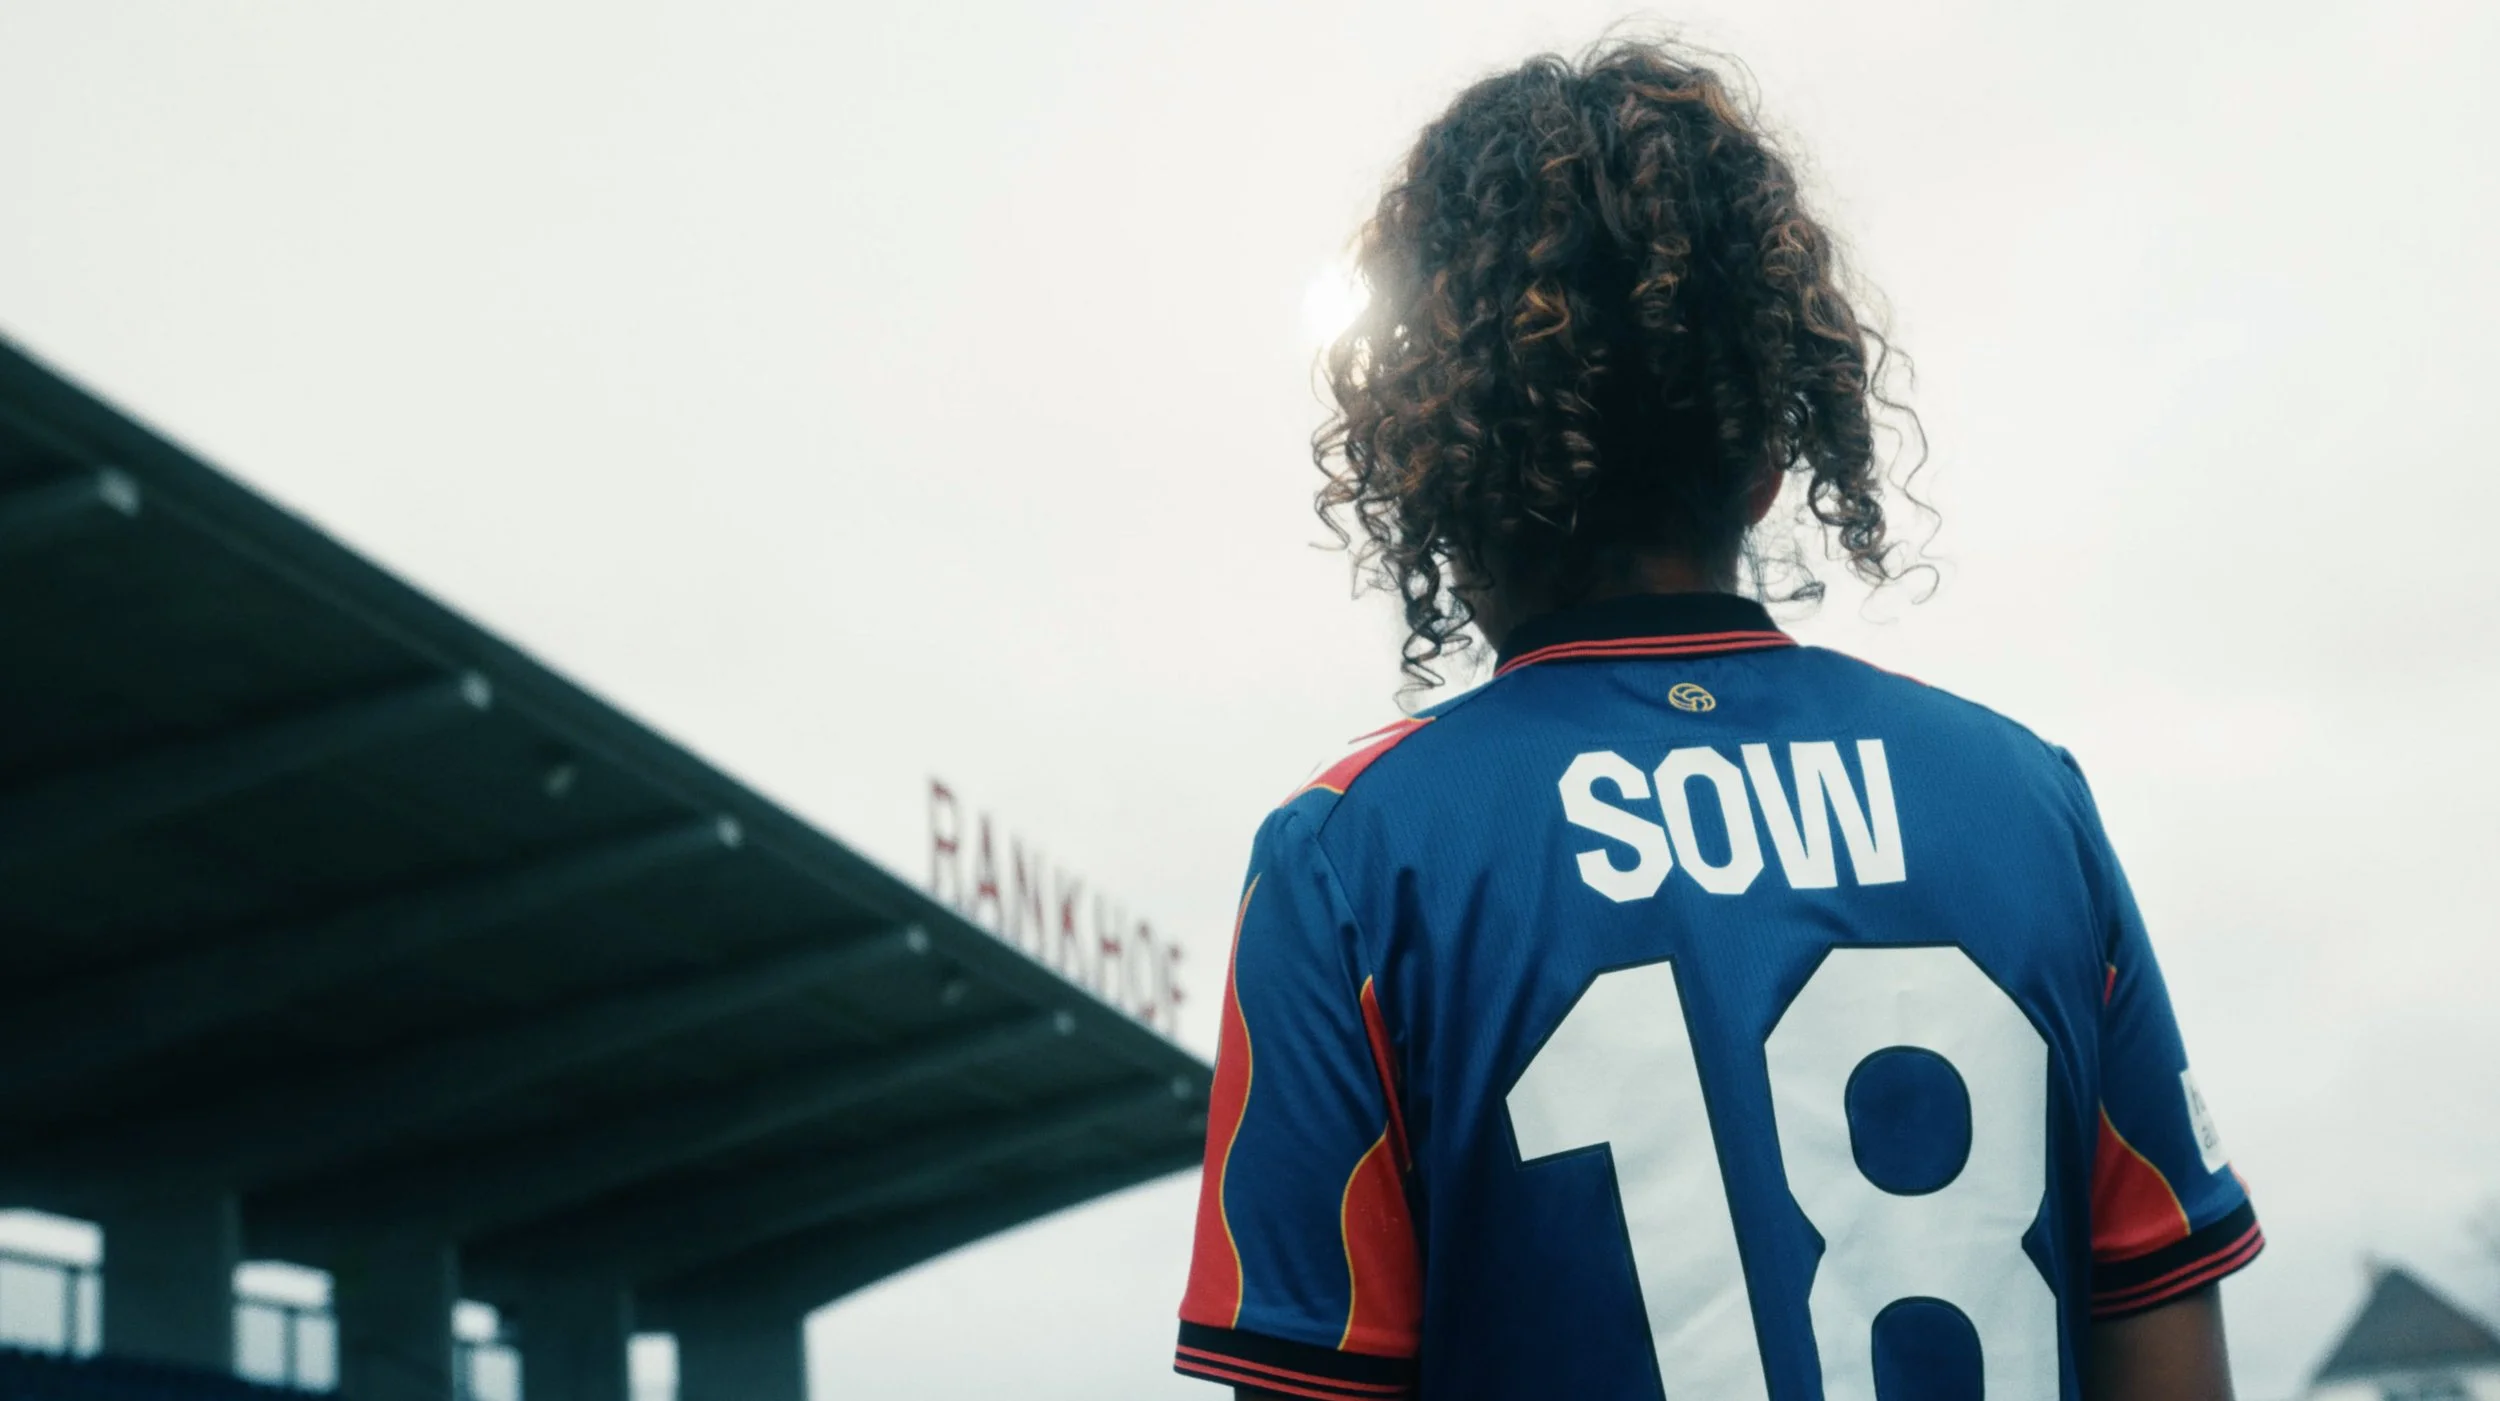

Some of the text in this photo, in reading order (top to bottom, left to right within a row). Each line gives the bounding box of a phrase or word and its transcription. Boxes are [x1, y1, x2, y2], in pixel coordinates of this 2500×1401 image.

[928, 778, 1186, 1040] RANKHOF
[1558, 739, 1906, 903] SOW
[1504, 945, 2061, 1401] 18
